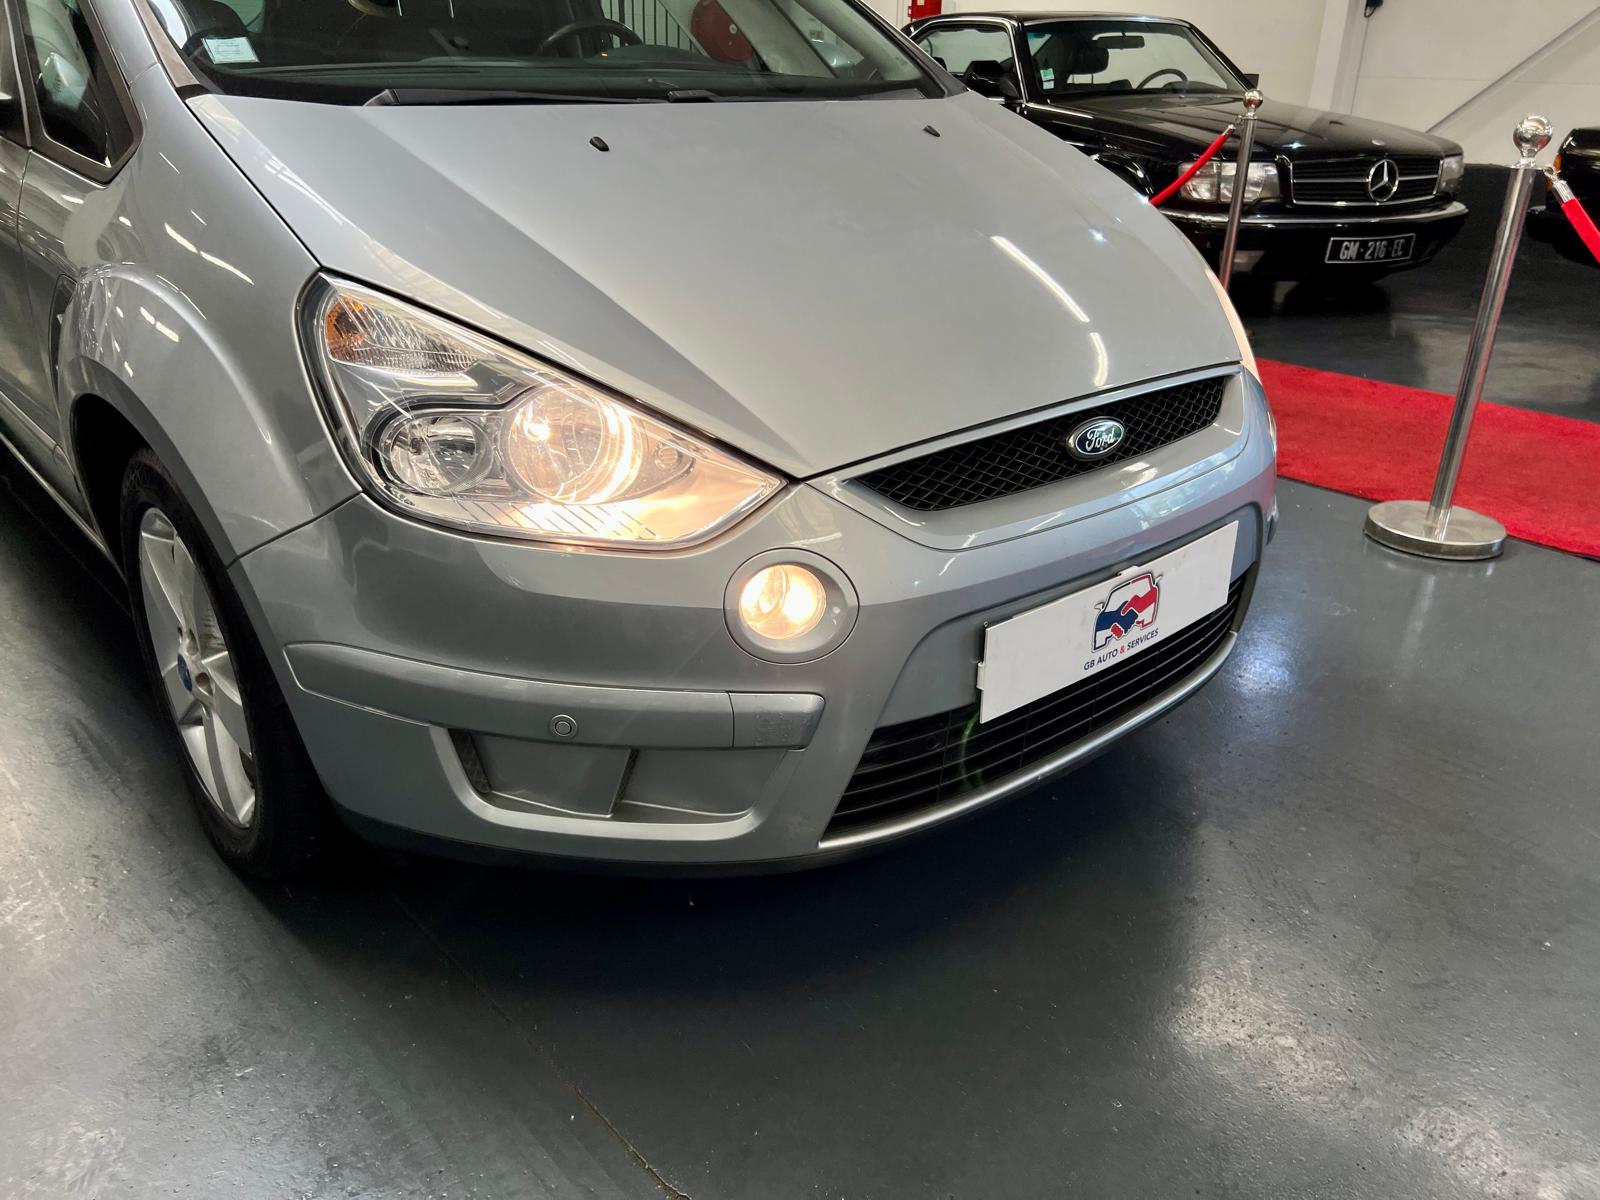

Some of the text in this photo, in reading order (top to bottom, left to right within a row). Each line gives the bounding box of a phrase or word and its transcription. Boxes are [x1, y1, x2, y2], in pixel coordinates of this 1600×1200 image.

[1085, 427, 1116, 451] Ford
[1084, 628, 1159, 670] GB AUTO & SERVICES
